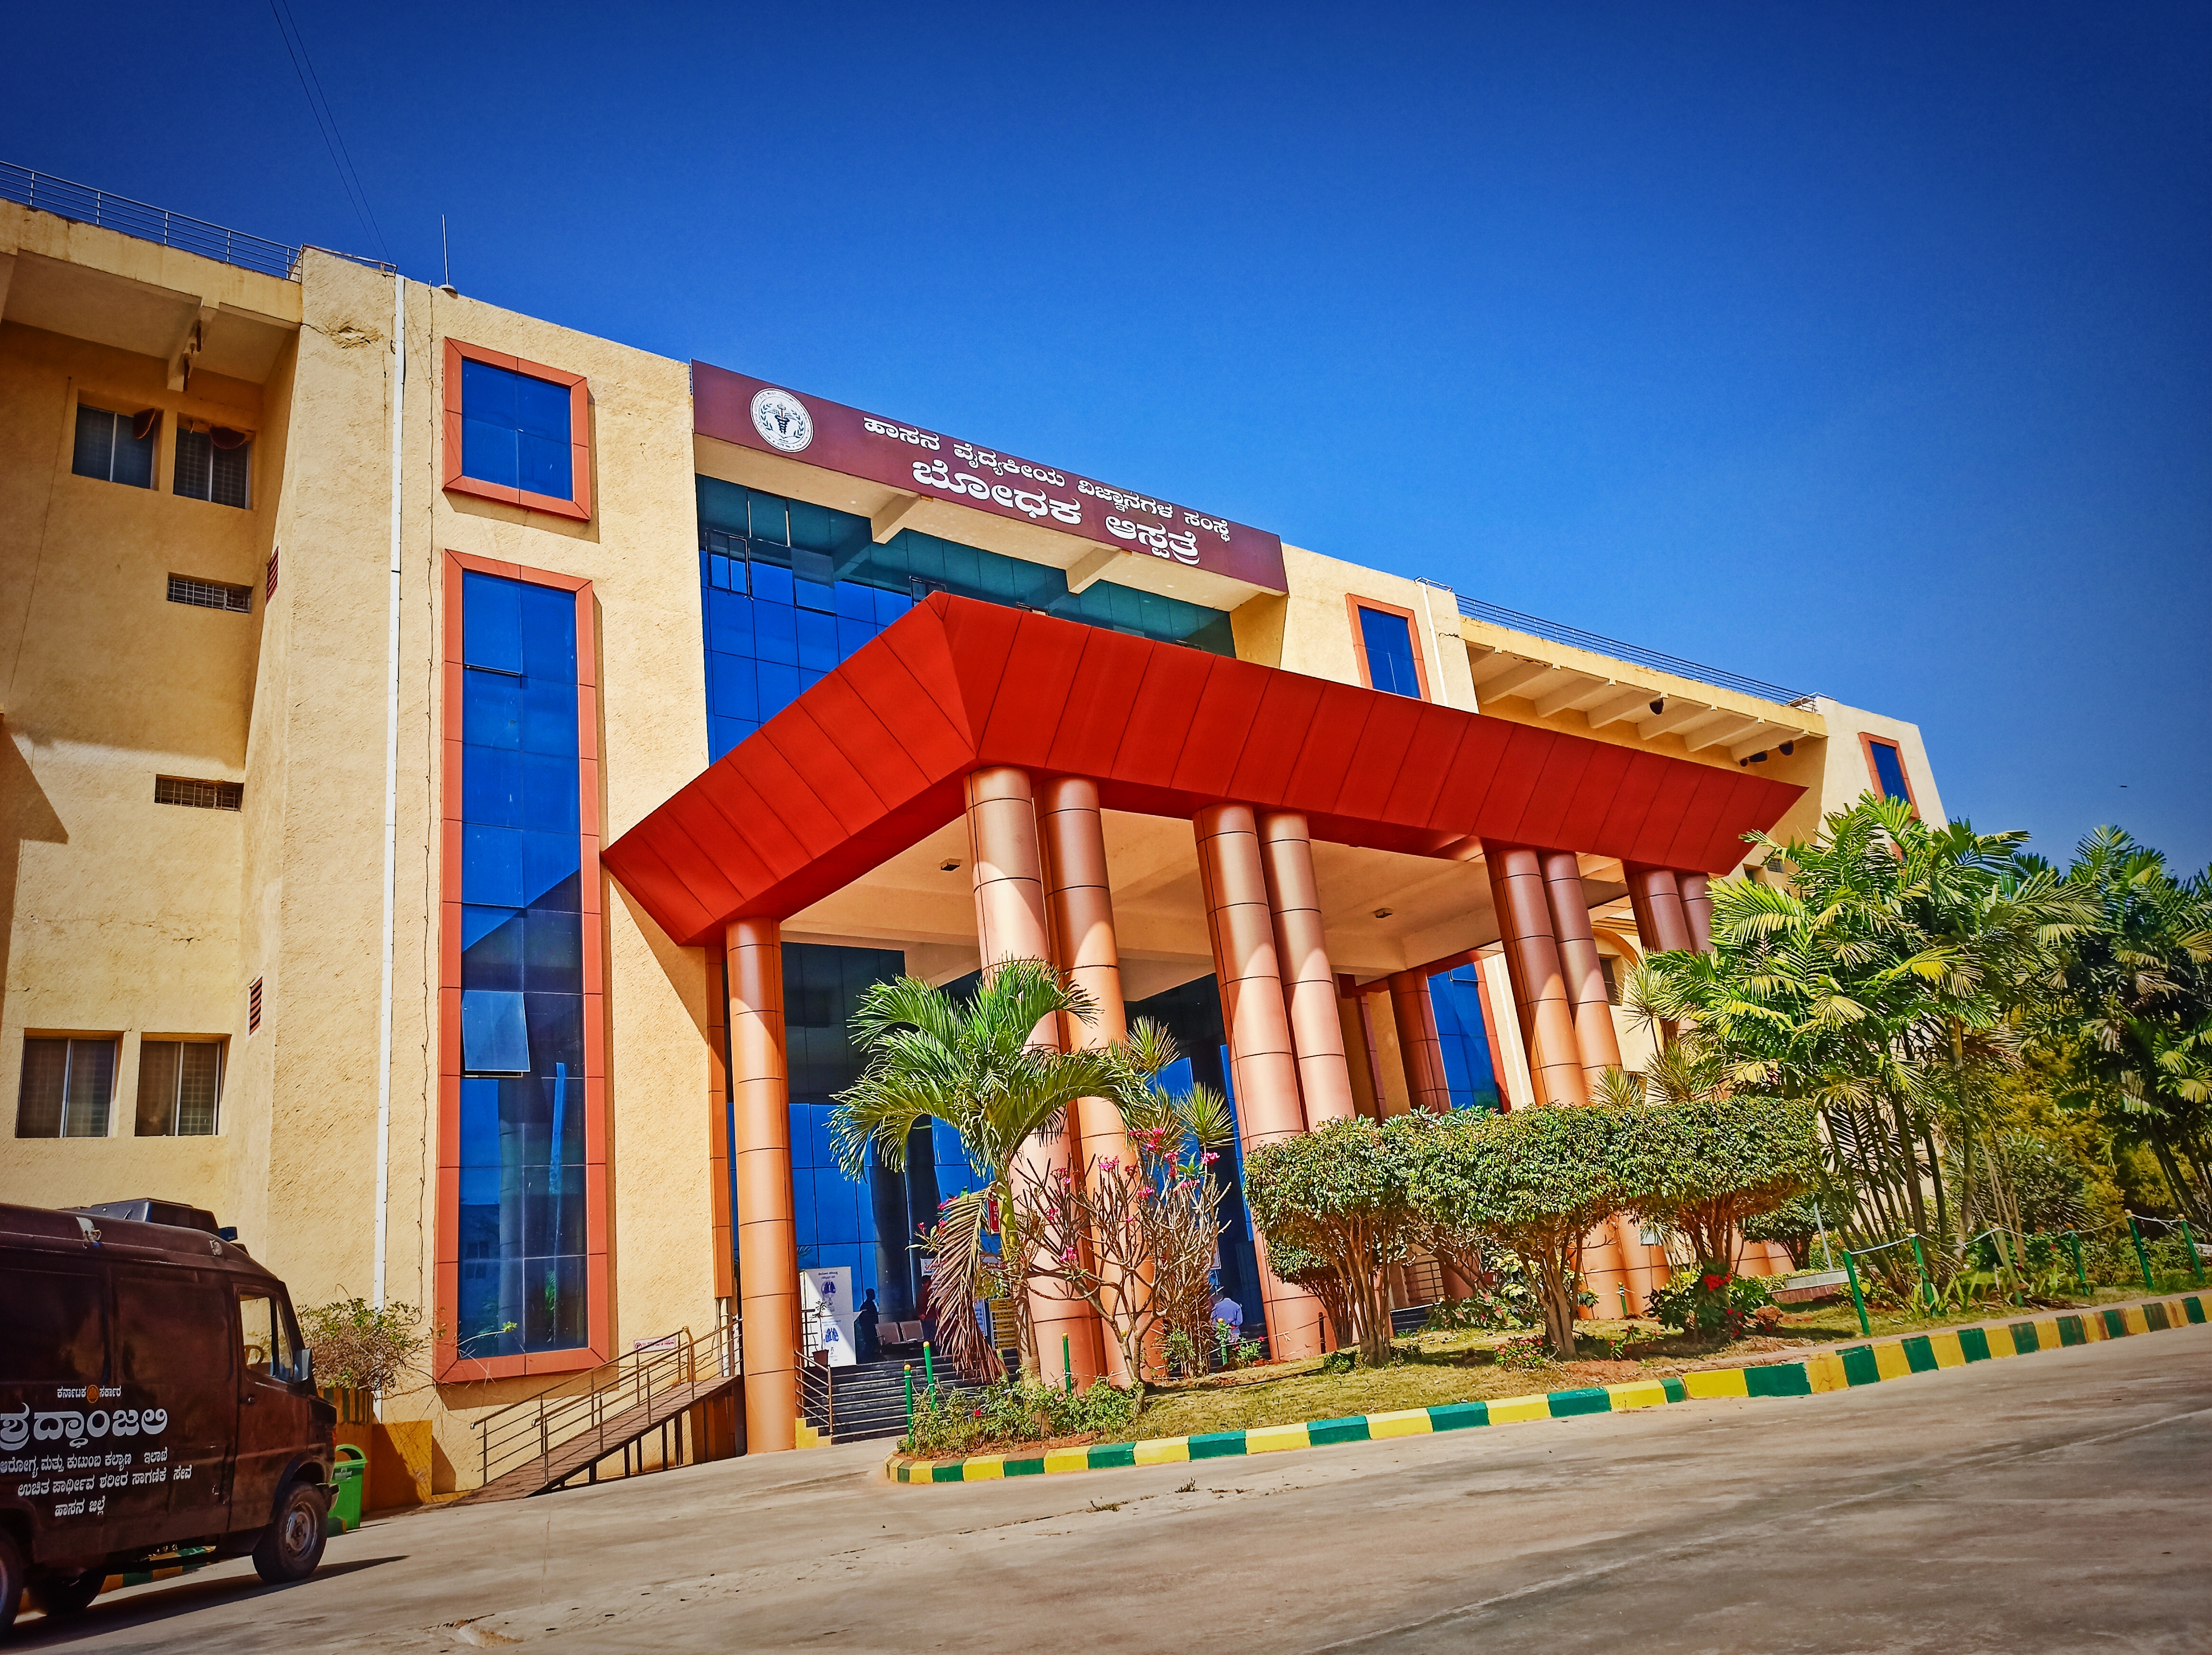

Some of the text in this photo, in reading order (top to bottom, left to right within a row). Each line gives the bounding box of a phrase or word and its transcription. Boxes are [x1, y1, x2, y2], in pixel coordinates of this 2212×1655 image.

[864, 417, 1230, 542] ಹಾಸನ ವೈದ್ಯಕೀಯ ವಿಜ್ಞಾನಗಳ ಸಂಸ್ಥೆ
[913, 459, 1201, 565] ಬೋಧಕ ಆಸ್ಪತ್ರೆ
[57, 1385, 122, 1398] ಕರ್ನಾಟಕ ಸರ್ಕಾರ
[0, 1402, 167, 1451] ಶ್ರದ್ಧಾಂಜಲಿ
[0, 1455, 39, 1478] ಆರೋಗ್ಯ
[41, 1455, 64, 1472] ಮತ್ತು
[66, 1454, 101, 1469] ಕುಟುಂಬ
[105, 1451, 132, 1471] ಕಲ್ಯಾಣ
[18, 1478, 50, 1497] ಉಚಿತ
[99, 1471, 128, 1489] ಶರೀರ
[173, 1464, 192, 1480] ಸೇವೆ
[55, 1495, 106, 1517] ಹಾಸನ ಜಿಲ್ಲೆ
